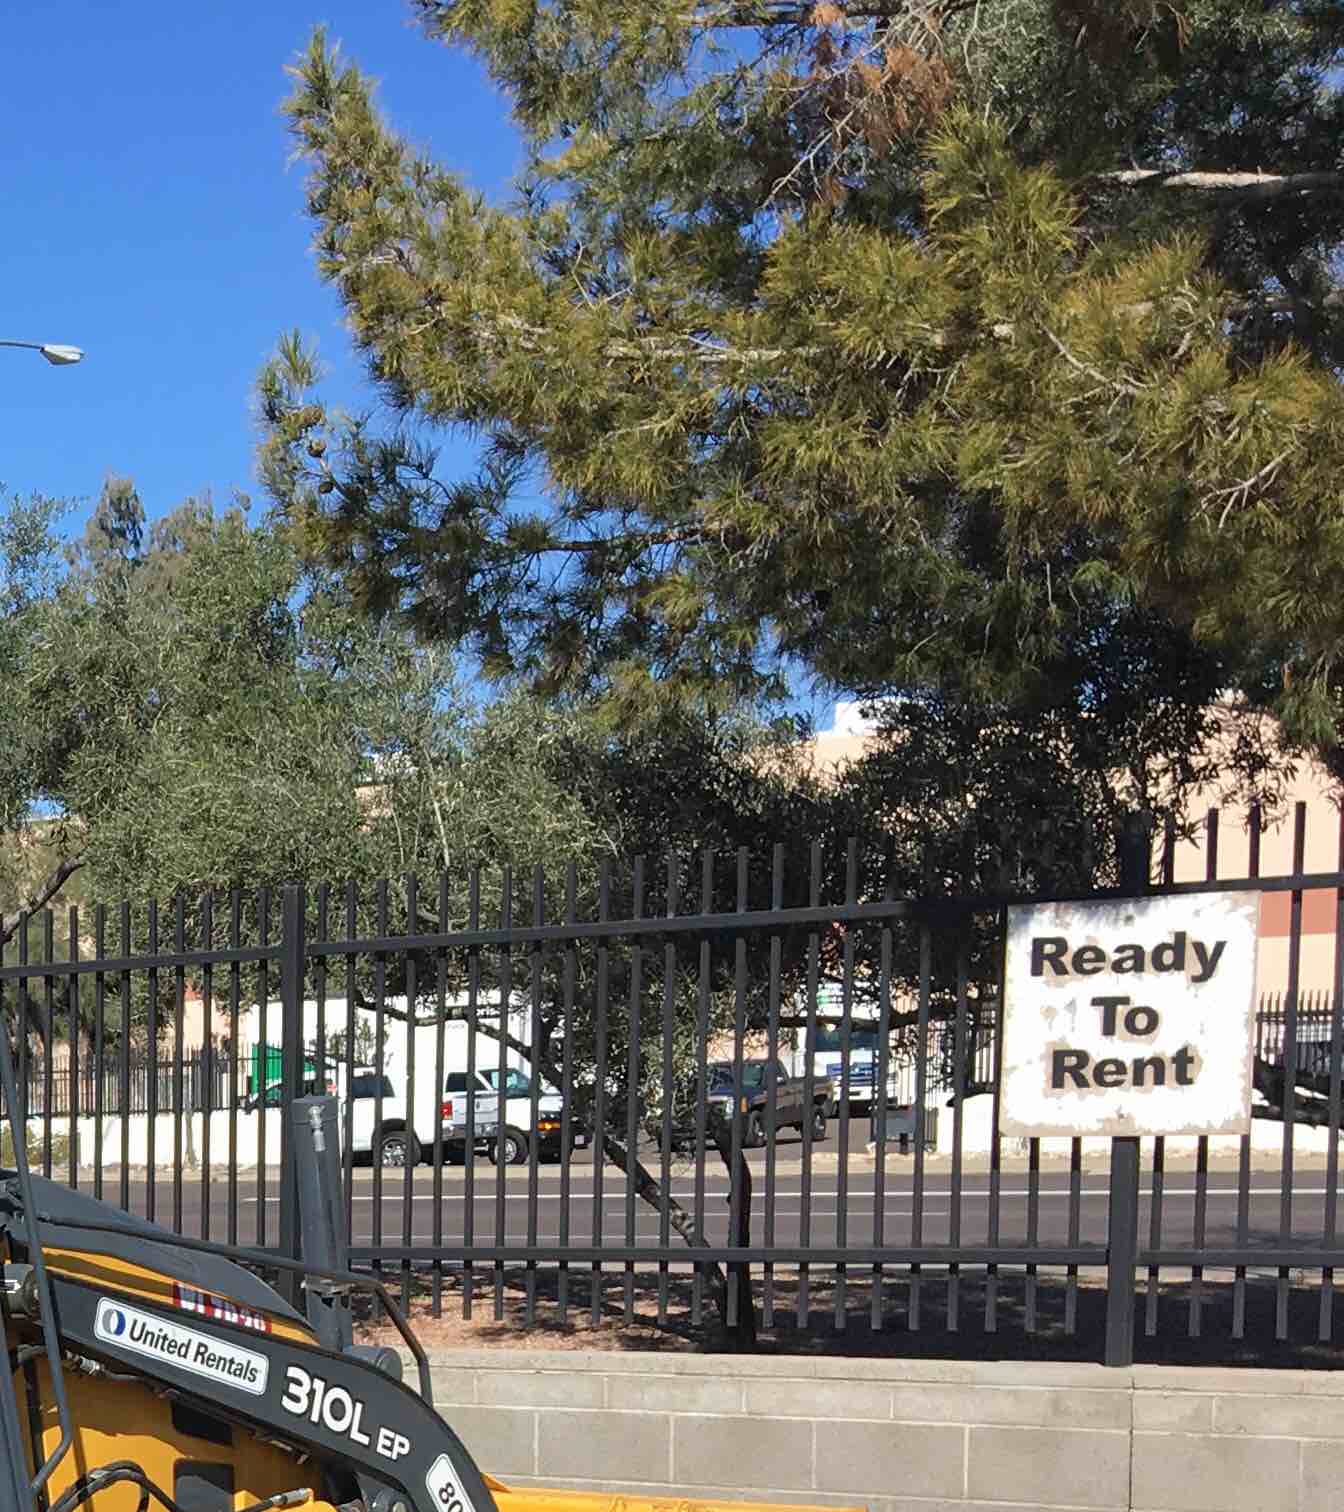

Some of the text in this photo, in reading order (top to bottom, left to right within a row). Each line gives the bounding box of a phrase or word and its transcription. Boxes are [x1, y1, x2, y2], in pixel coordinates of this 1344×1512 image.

[1030, 931, 1227, 983] Ready
[1090, 996, 1159, 1036] To
[1052, 1047, 1194, 1089] Rent
[130, 1320, 259, 1383] United Rentals
[281, 1366, 410, 1460] 310L EP
